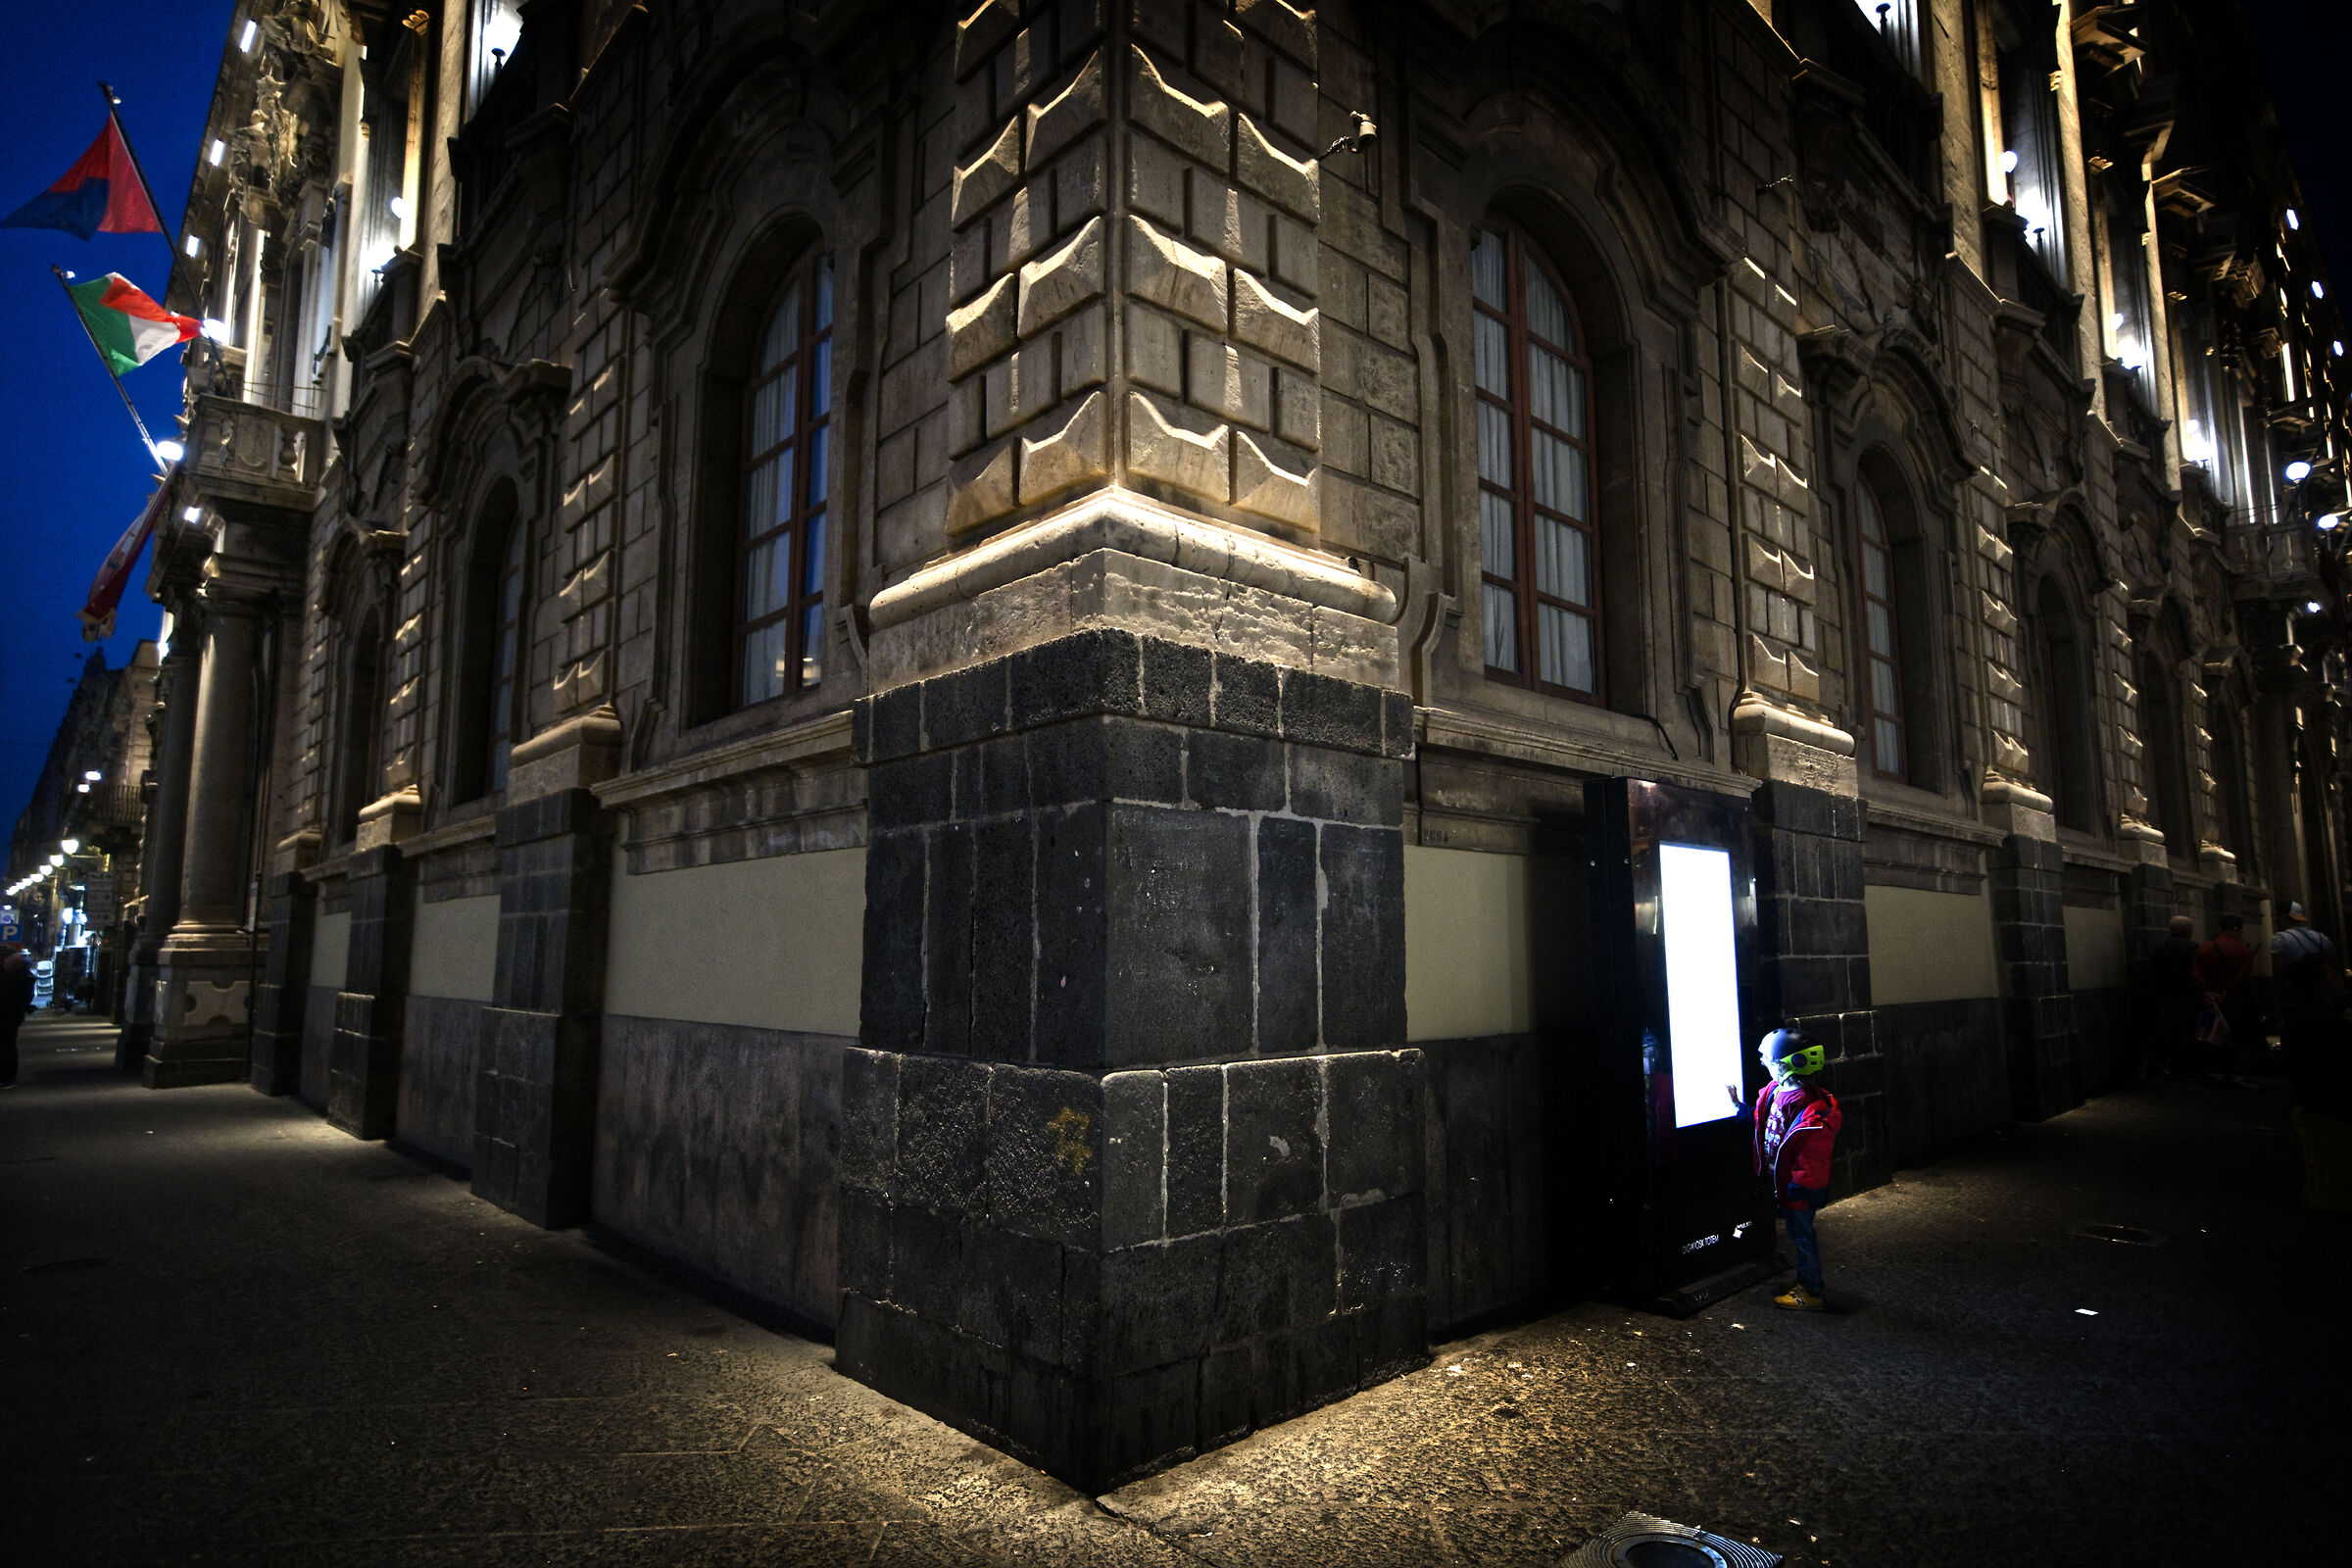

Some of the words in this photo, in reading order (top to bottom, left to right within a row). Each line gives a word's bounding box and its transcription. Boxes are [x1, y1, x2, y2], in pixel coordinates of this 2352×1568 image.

[3, 925, 18, 941] P
[1705, 1234, 1719, 1246] TOTEM
[1796, 1298, 1806, 1306] N
